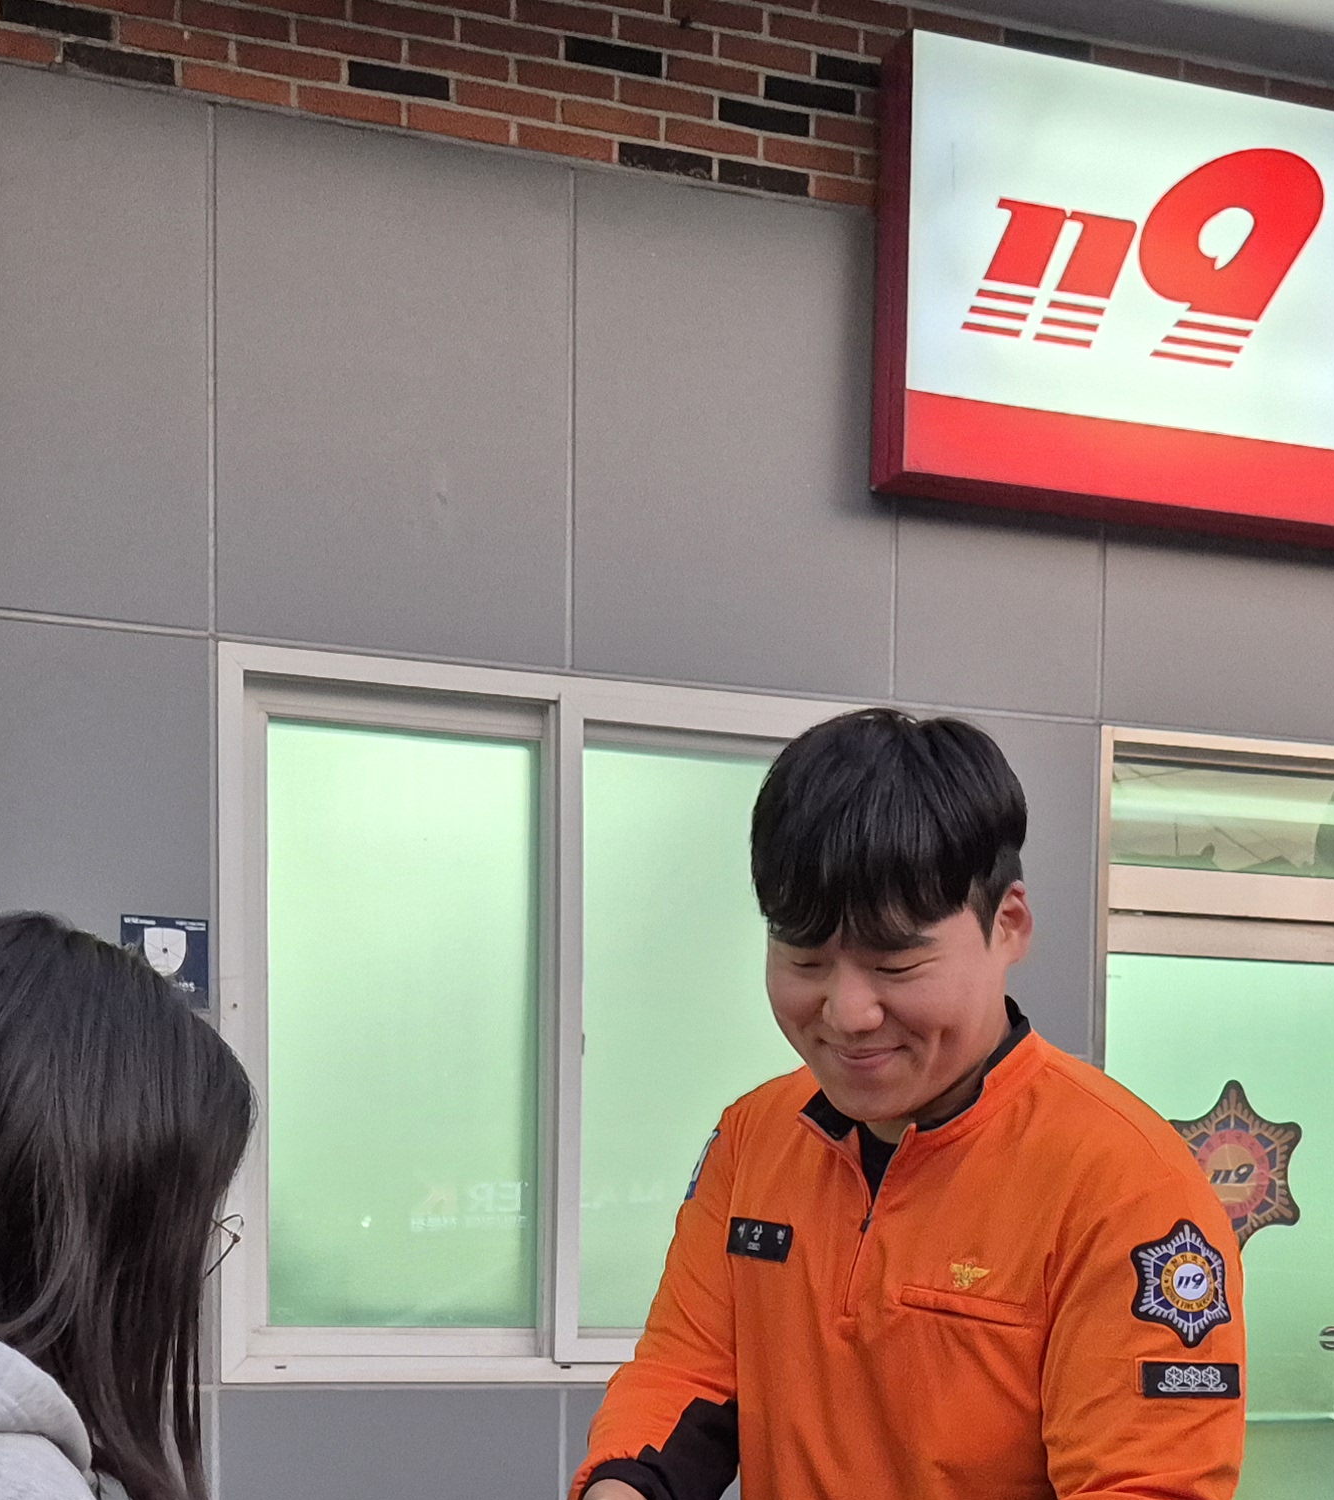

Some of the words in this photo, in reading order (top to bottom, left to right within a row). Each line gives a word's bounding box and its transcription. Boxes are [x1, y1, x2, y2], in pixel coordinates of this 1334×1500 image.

[960, 147, 1325, 369] 119
[1210, 1162, 1257, 1184] 119
[1176, 1272, 1205, 1290] 119
